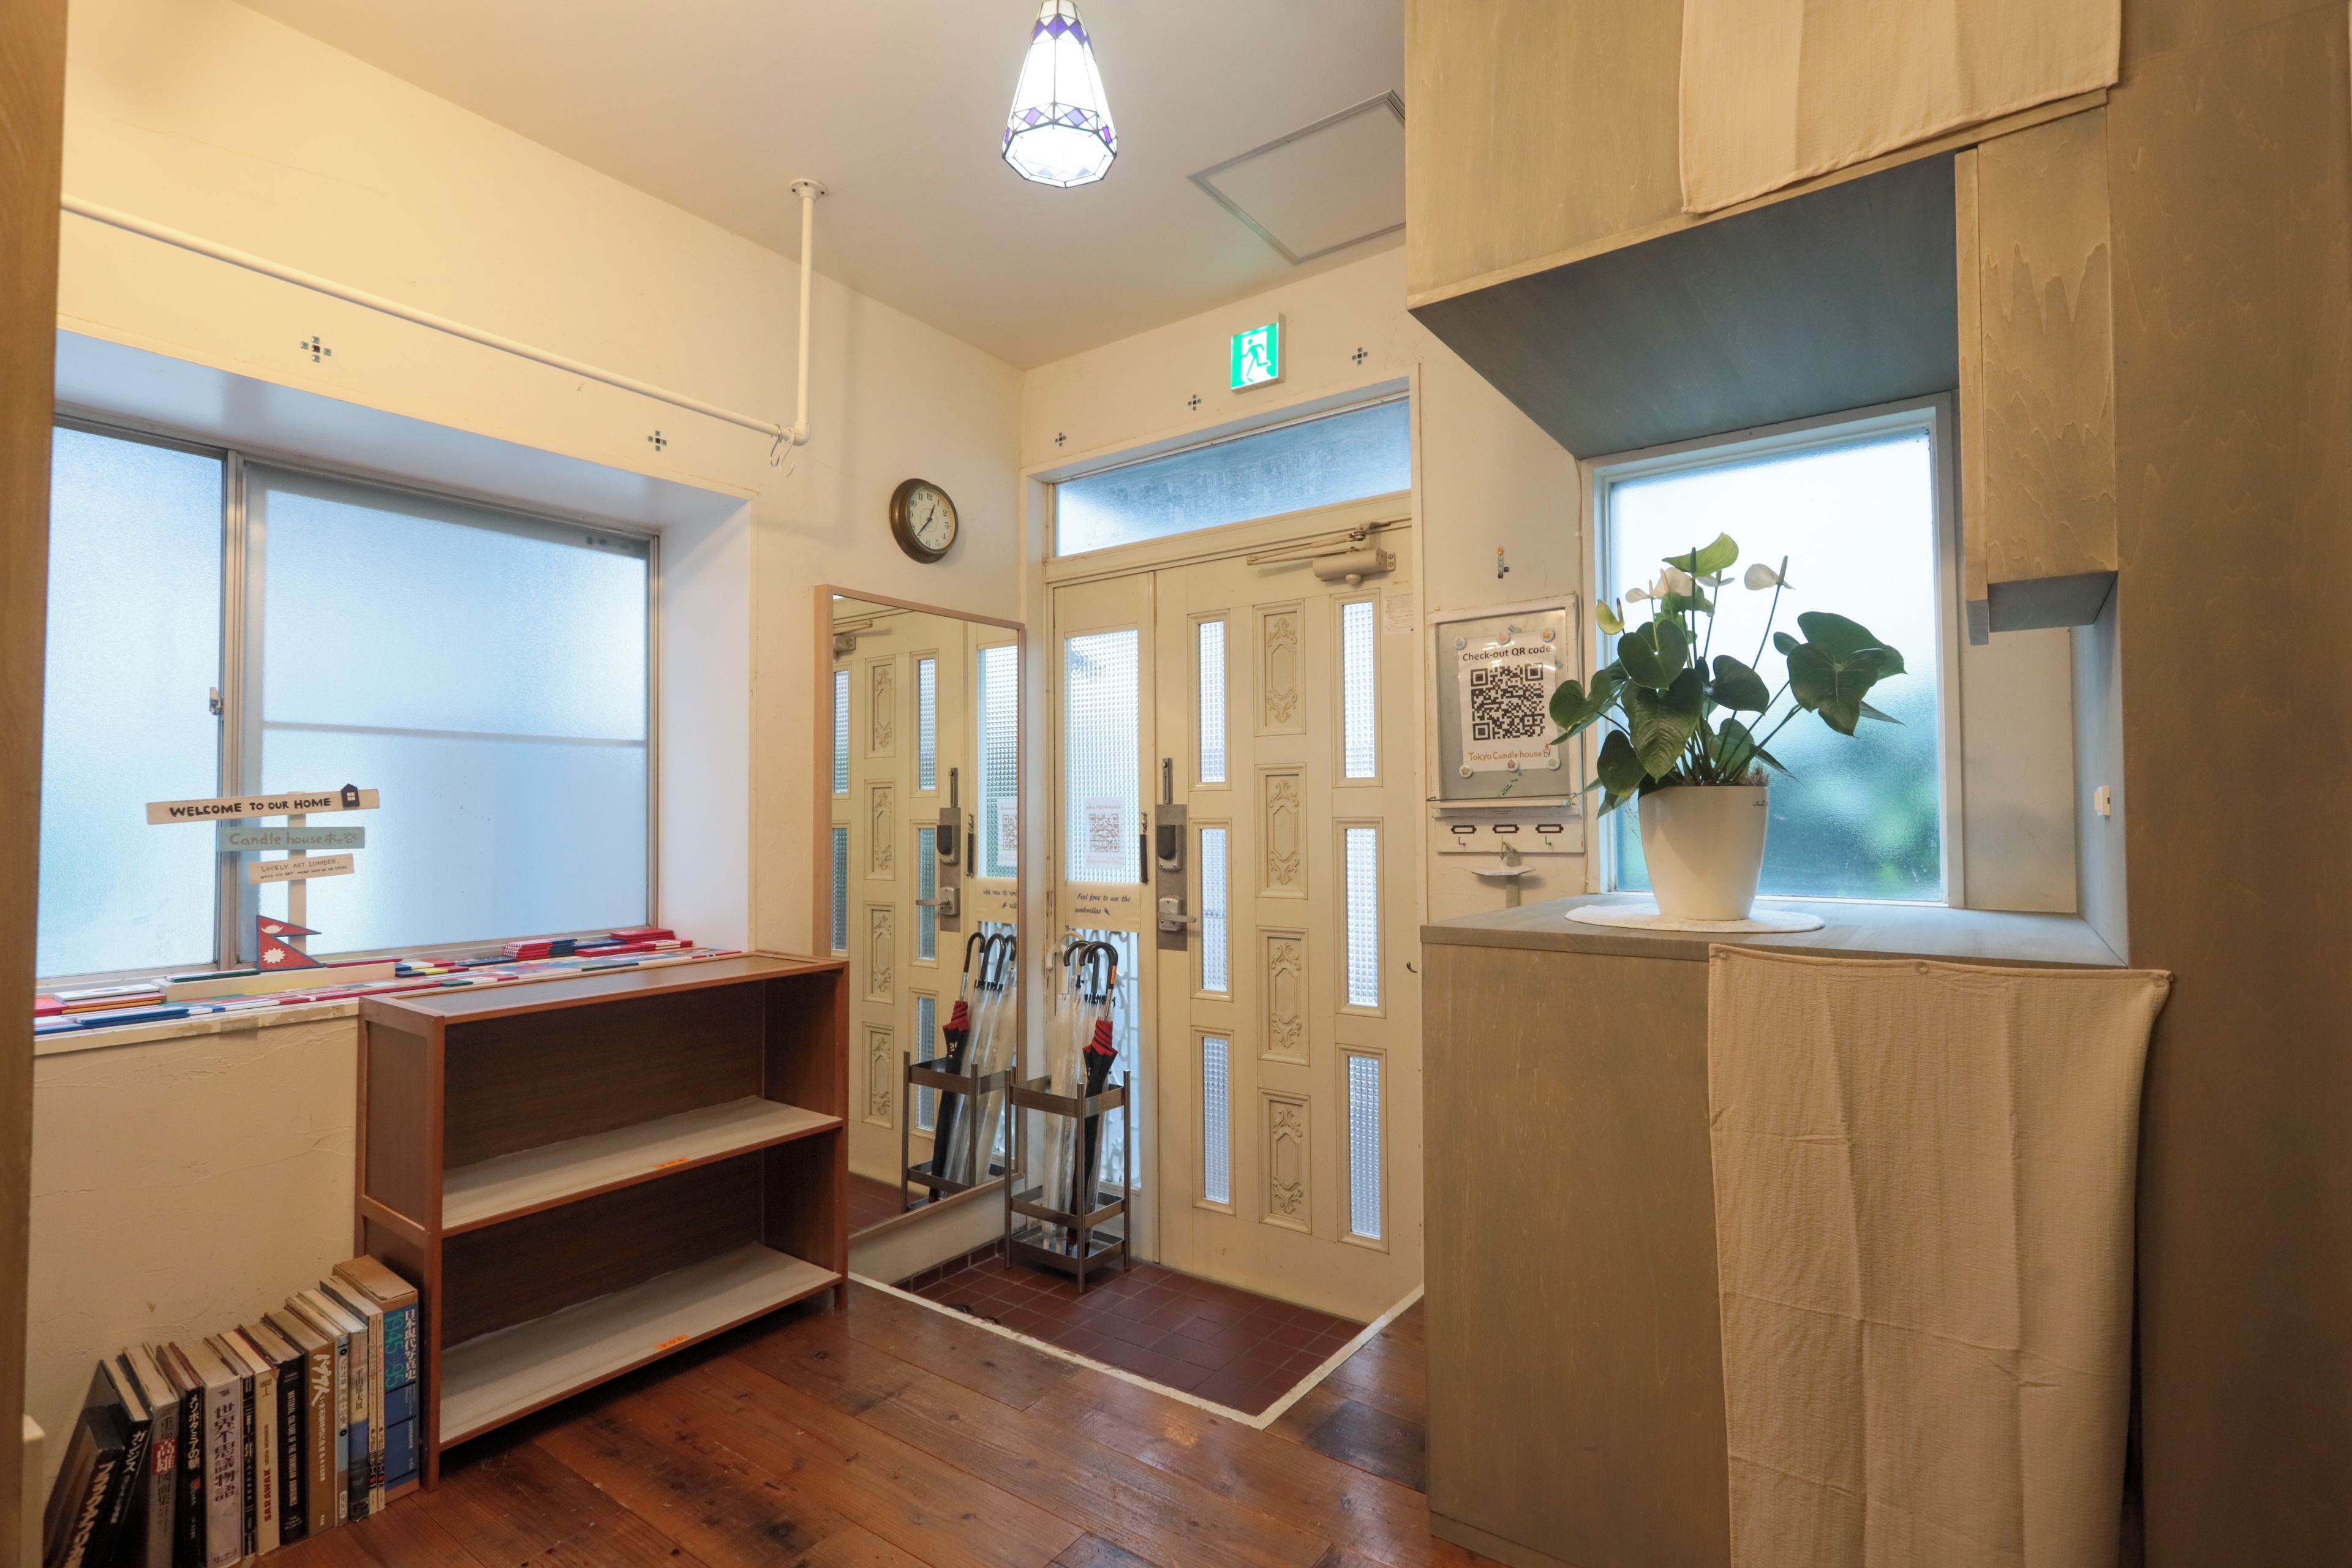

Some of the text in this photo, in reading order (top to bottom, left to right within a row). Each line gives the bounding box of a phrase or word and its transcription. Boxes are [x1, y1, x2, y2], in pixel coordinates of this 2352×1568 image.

[1463, 644, 1551, 662] Check-out QR code
[1468, 750, 1542, 761] Tokyo Candle house
[170, 798, 331, 817] WELCOME TO OUR HOME
[228, 832, 281, 846] Candle
[286, 832, 323, 845] house
[309, 859, 339, 867] LUMBER.
[1089, 893, 1101, 902] free
[404, 1308, 417, 1382] 日本現代写真史
[123, 1430, 148, 1474] ガンジス
[214, 1402, 235, 1501] 世界不思議物語
